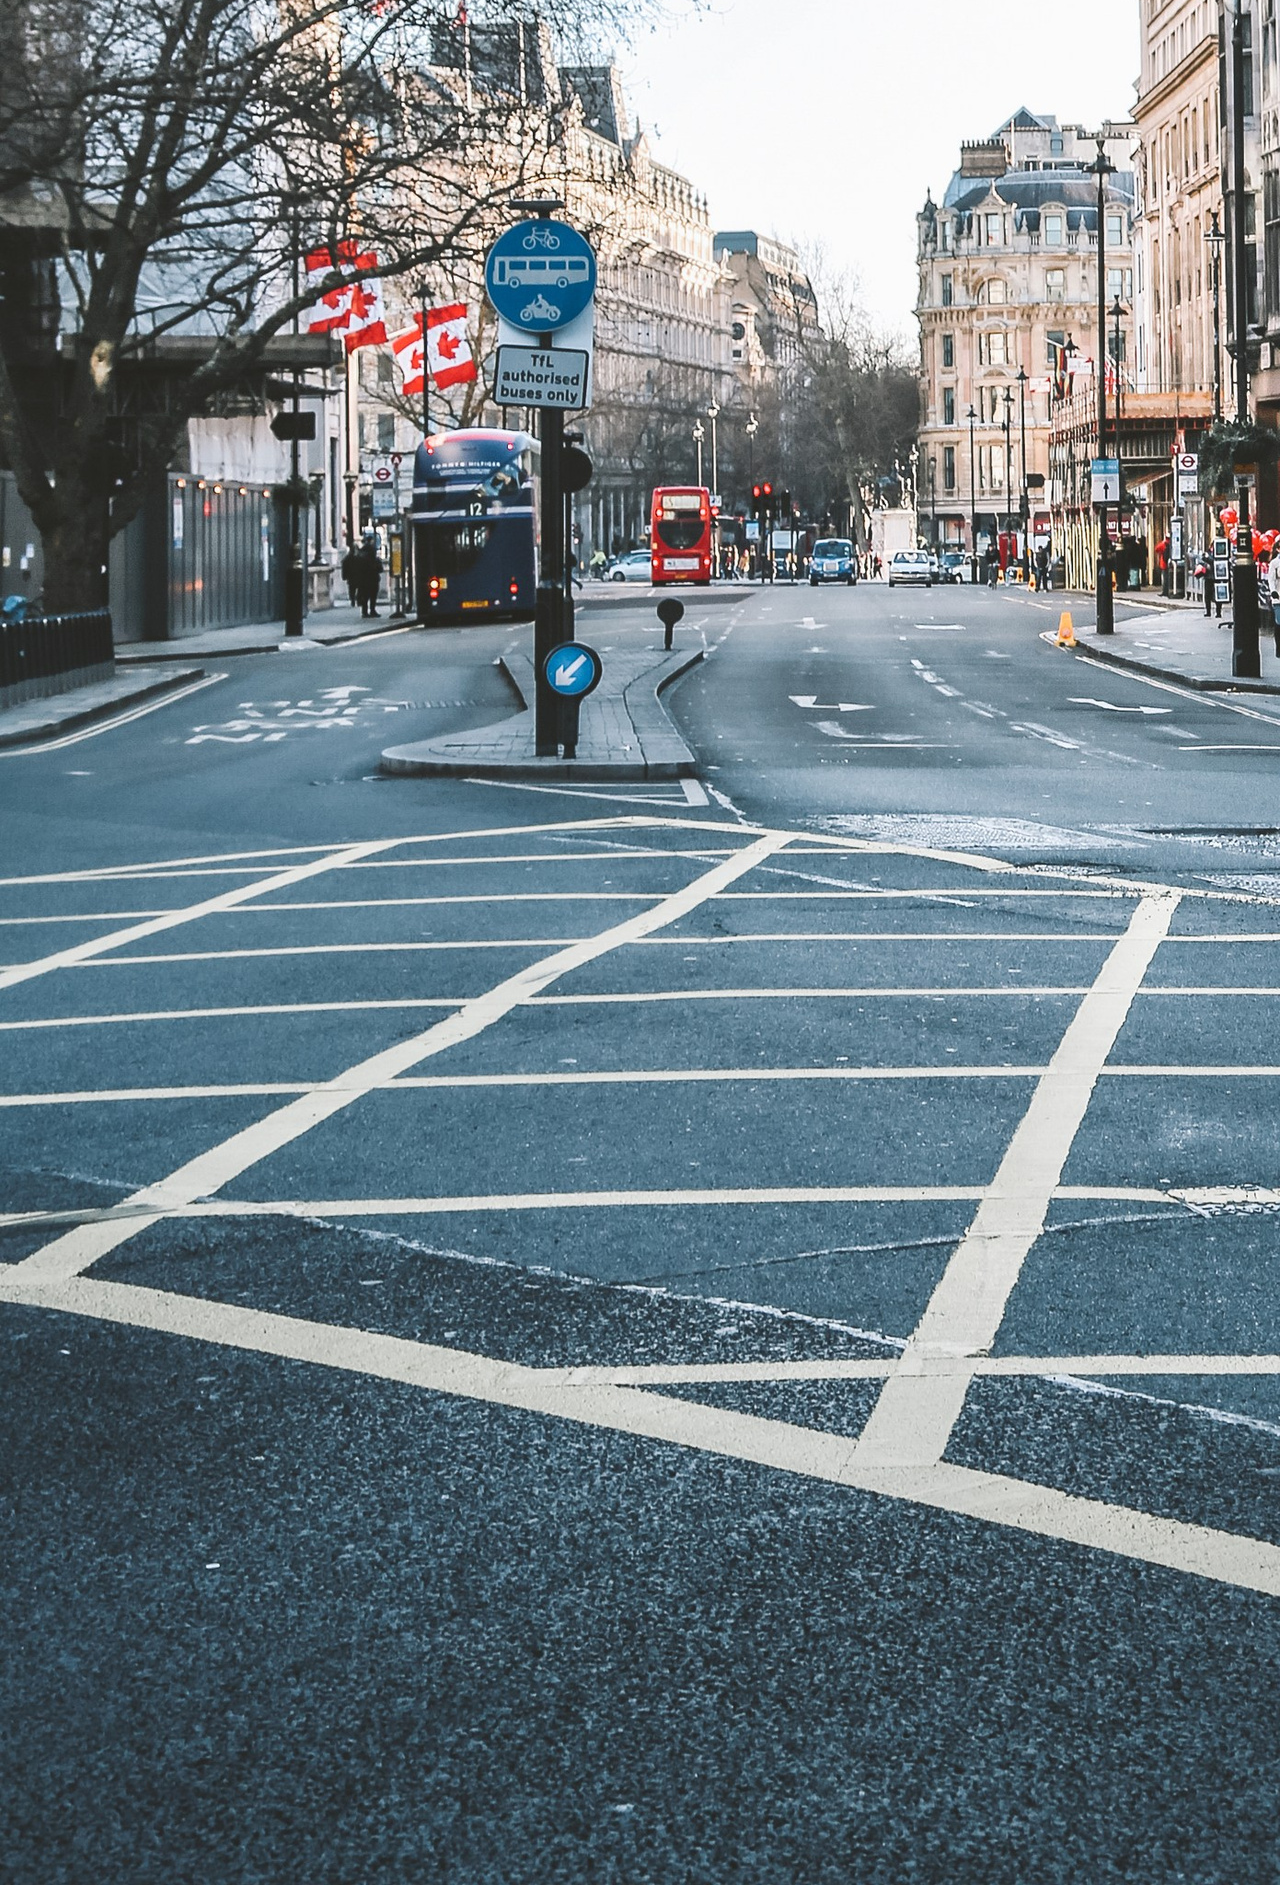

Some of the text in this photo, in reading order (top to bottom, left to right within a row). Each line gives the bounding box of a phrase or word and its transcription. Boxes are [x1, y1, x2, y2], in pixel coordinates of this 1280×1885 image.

[531, 354, 554, 368] TfL
[502, 370, 580, 386] authorised
[500, 385, 578, 404] buses only
[470, 502, 482, 516] 12
